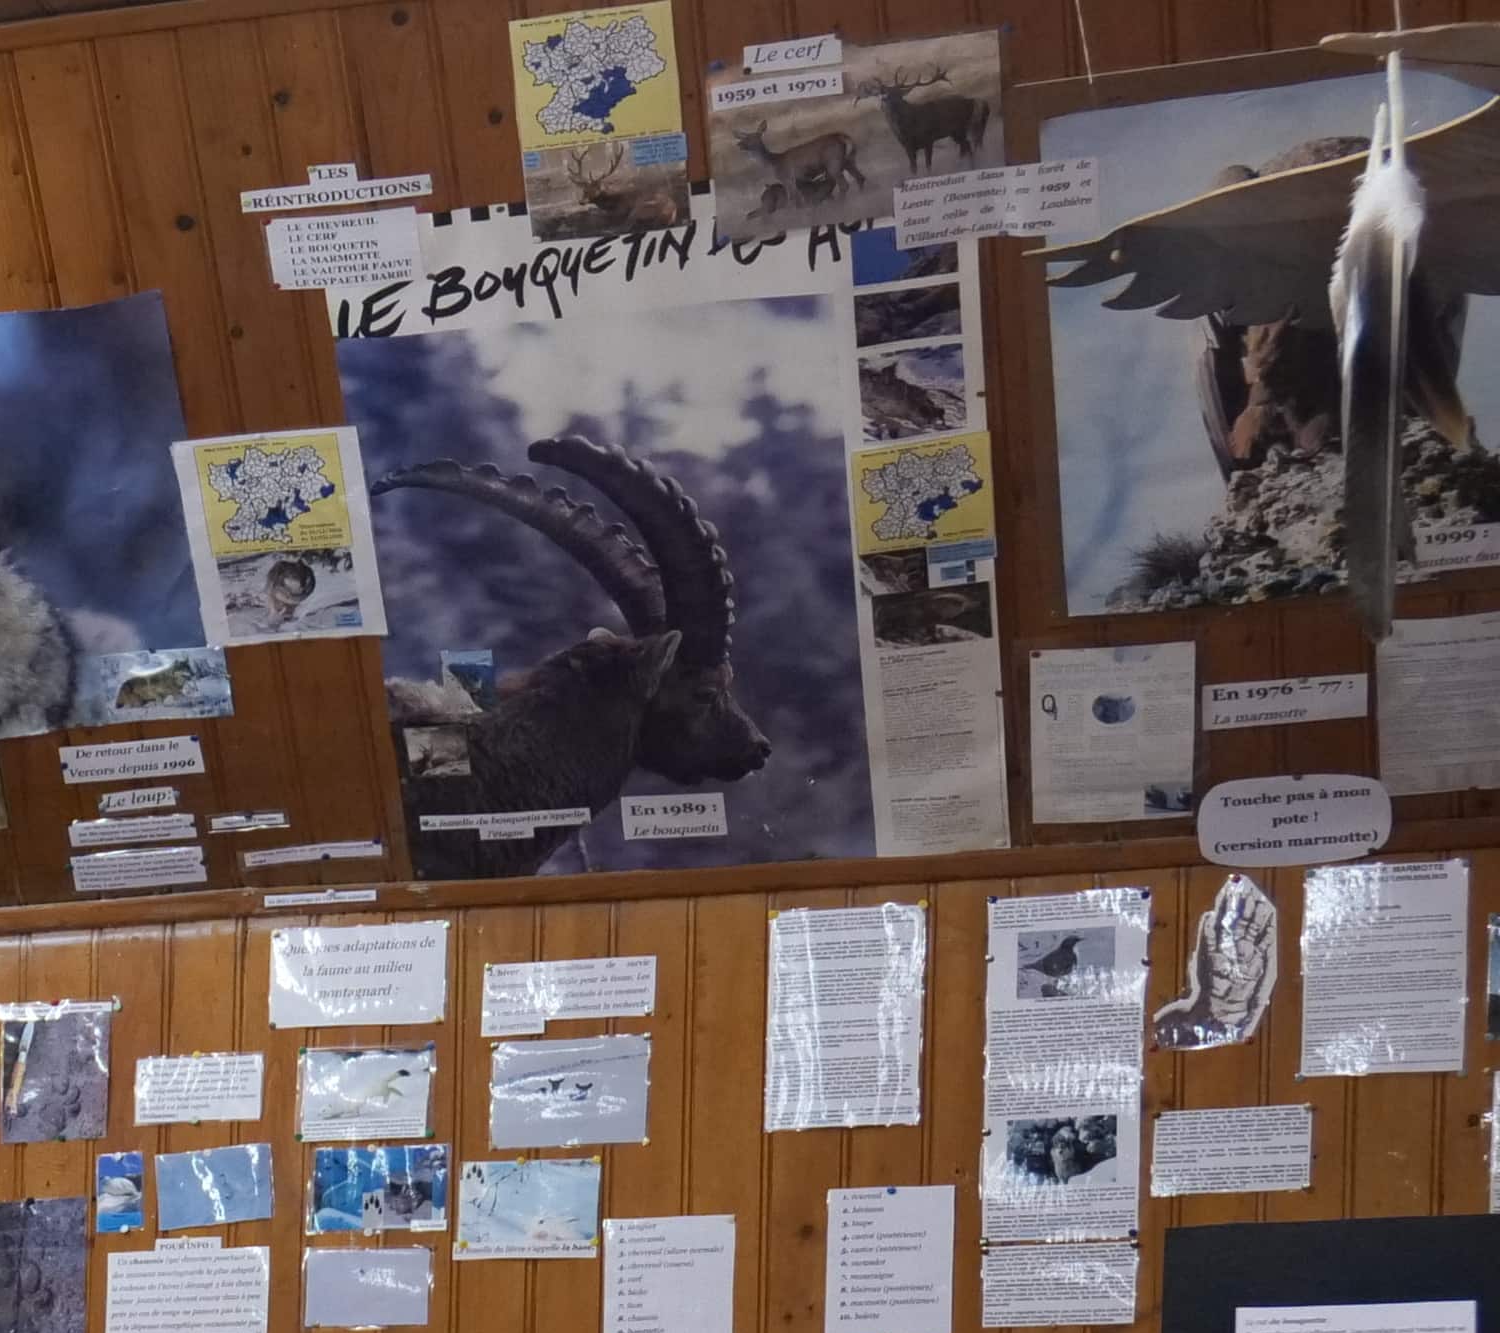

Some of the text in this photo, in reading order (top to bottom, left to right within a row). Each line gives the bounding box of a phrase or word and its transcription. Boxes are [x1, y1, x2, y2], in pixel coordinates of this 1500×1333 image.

[754, 38, 827, 65] Le cerf
[717, 77, 827, 103] 1959 et 1970
[318, 166, 349, 180] LES
[251, 180, 421, 209] RÉINTRODUCTIONS
[307, 216, 378, 230] CHEVREUIL
[307, 231, 338, 242] CERF
[308, 240, 379, 253] BOUQUETIN
[310, 251, 380, 265] MARMOTTE
[311, 263, 369, 275] VAUTOUR
[373, 258, 412, 270] FAUVE
[337, 281, 414, 338] LE
[1424, 528, 1476, 545] 1999
[1212, 687, 1240, 702] En
[1246, 682, 1294, 701] 1976
[1235, 707, 1308, 724] marmotte
[75, 740, 179, 759] De retour dans le
[69, 757, 195, 778] Vercors depuis 1996
[105, 795, 125, 809] Le
[1220, 786, 1371, 808] Touche pas à mon
[630, 802, 707, 817] En 1989
[1272, 812, 1309, 828] pote
[633, 823, 720, 837] Le bouquetin
[1213, 830, 1379, 854] (version marmotte)
[342, 936, 436, 953] adaptations de
[302, 960, 413, 979] la faune au milieu
